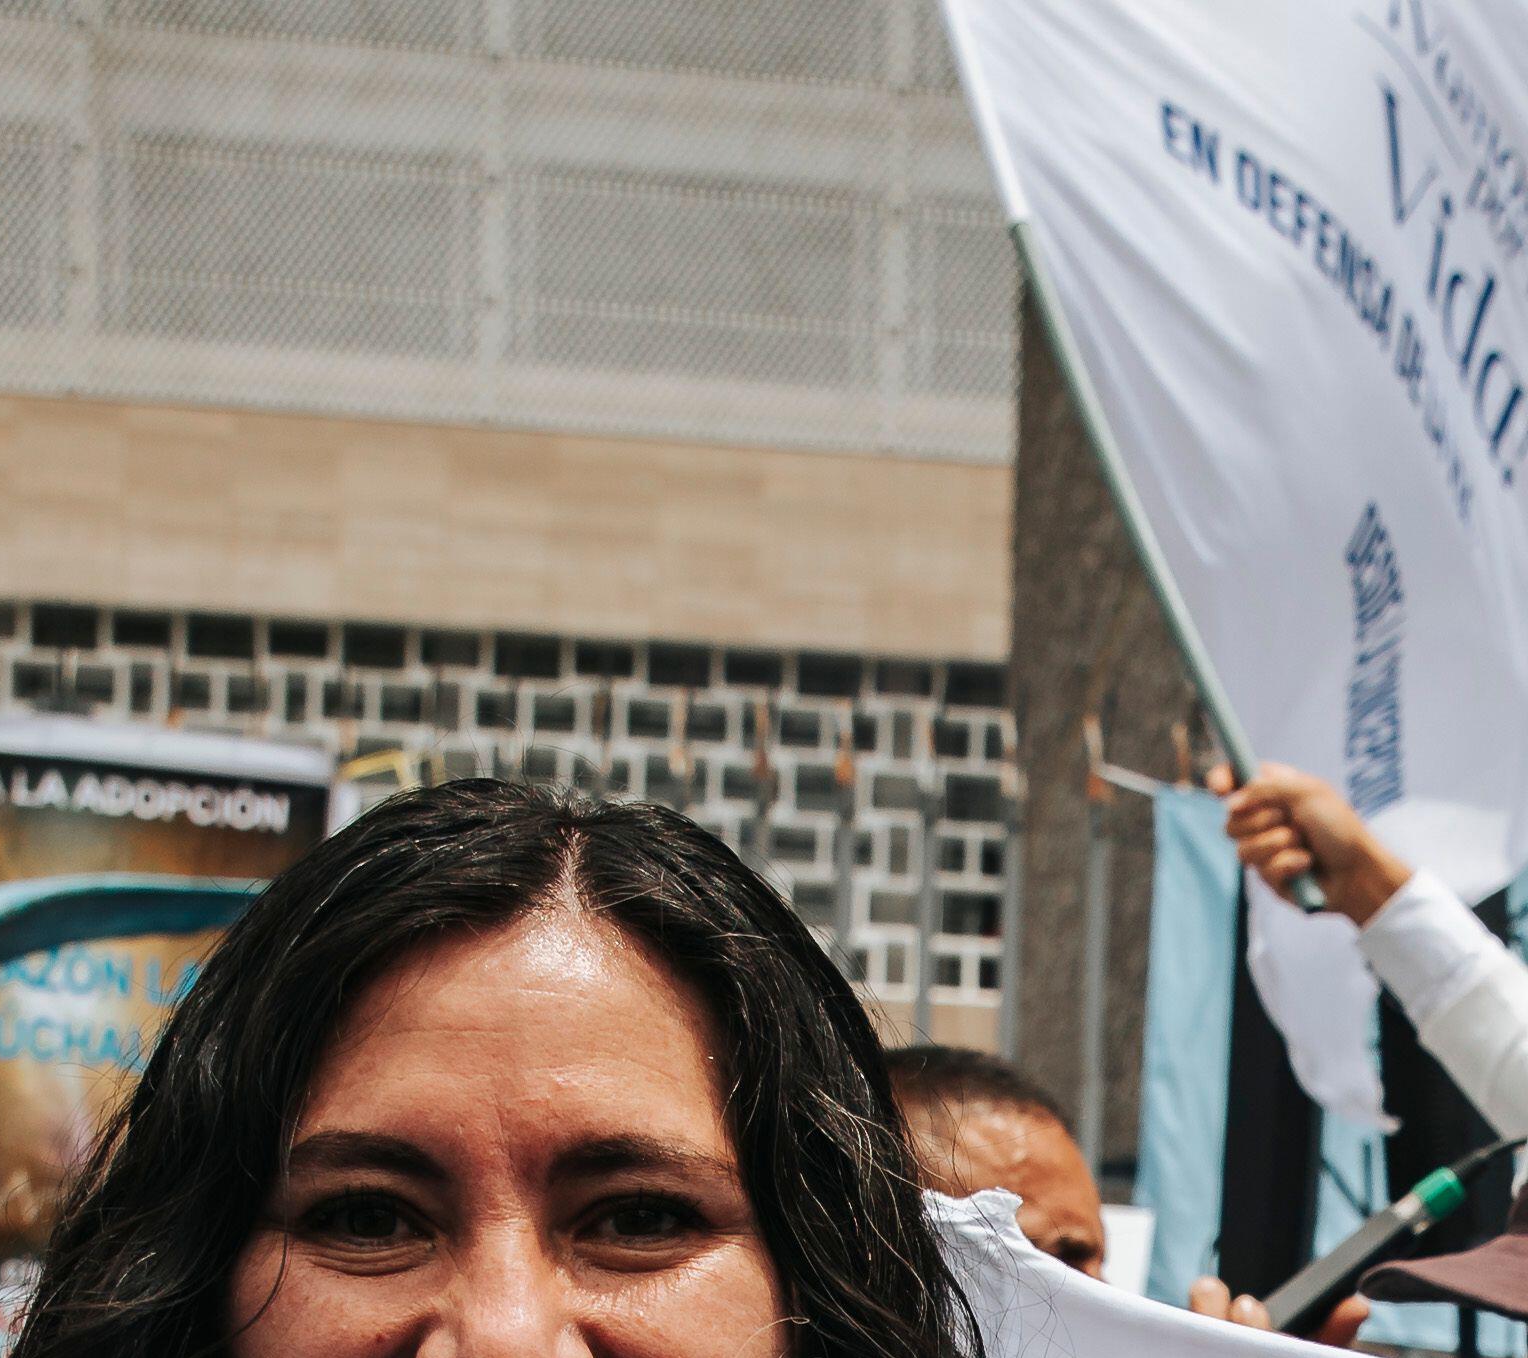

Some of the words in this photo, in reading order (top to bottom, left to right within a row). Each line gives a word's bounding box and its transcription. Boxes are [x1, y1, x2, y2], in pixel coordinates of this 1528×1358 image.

[1158, 96, 1221, 187] EN
[1231, 146, 1396, 354] DEFENSA
[9, 766, 72, 809] LA
[72, 771, 292, 836] ADOPCIÓN
